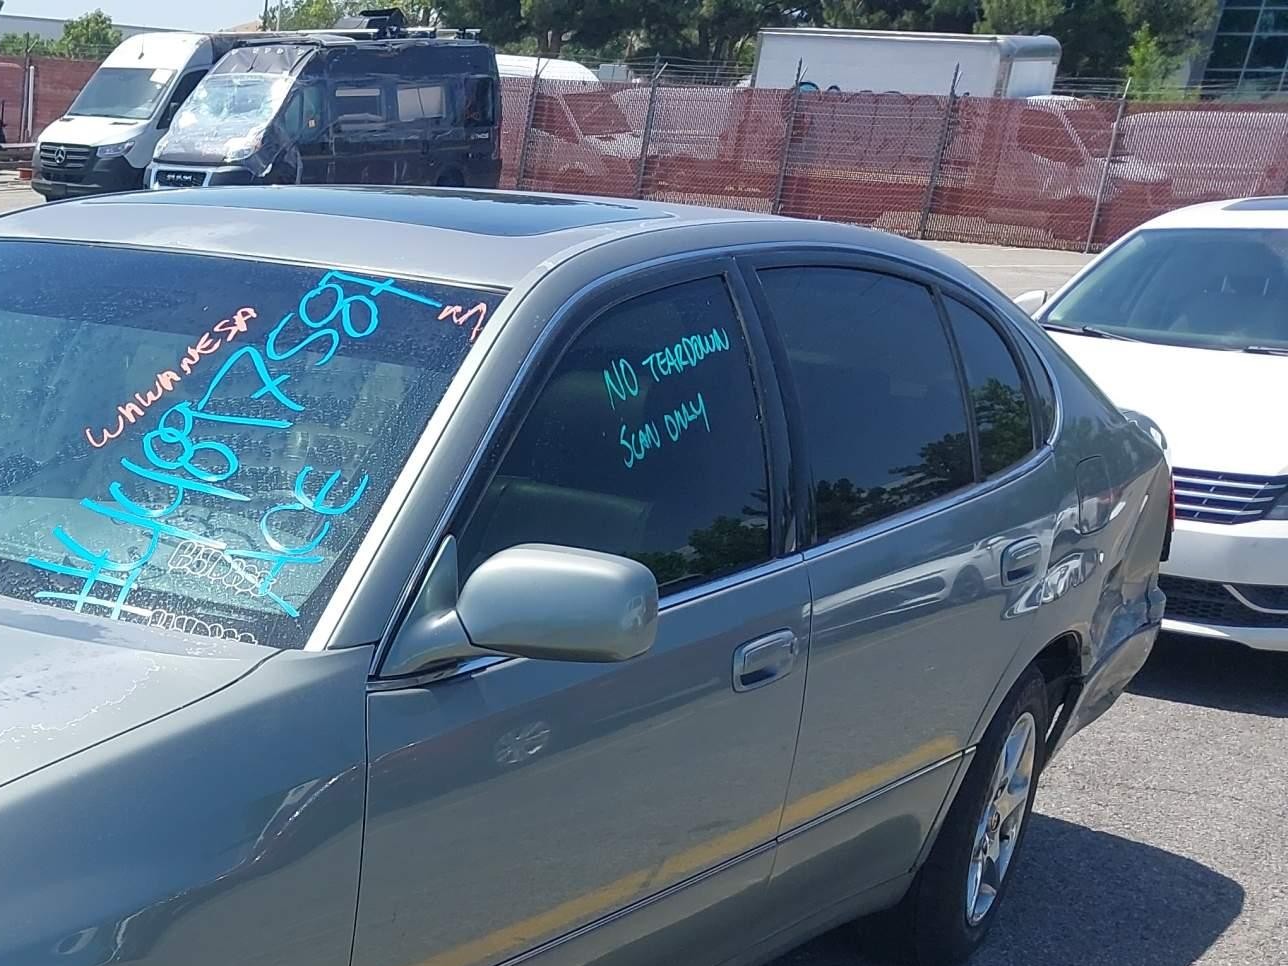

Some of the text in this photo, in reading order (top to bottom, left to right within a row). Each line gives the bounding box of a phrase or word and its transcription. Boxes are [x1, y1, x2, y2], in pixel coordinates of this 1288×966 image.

[85, 307, 258, 449] WAWANESA
[602, 327, 731, 410] NO TEARDOWN
[663, 391, 711, 443] ONLY
[27, 270, 444, 620] #44897587
[223, 465, 370, 618] ACE
